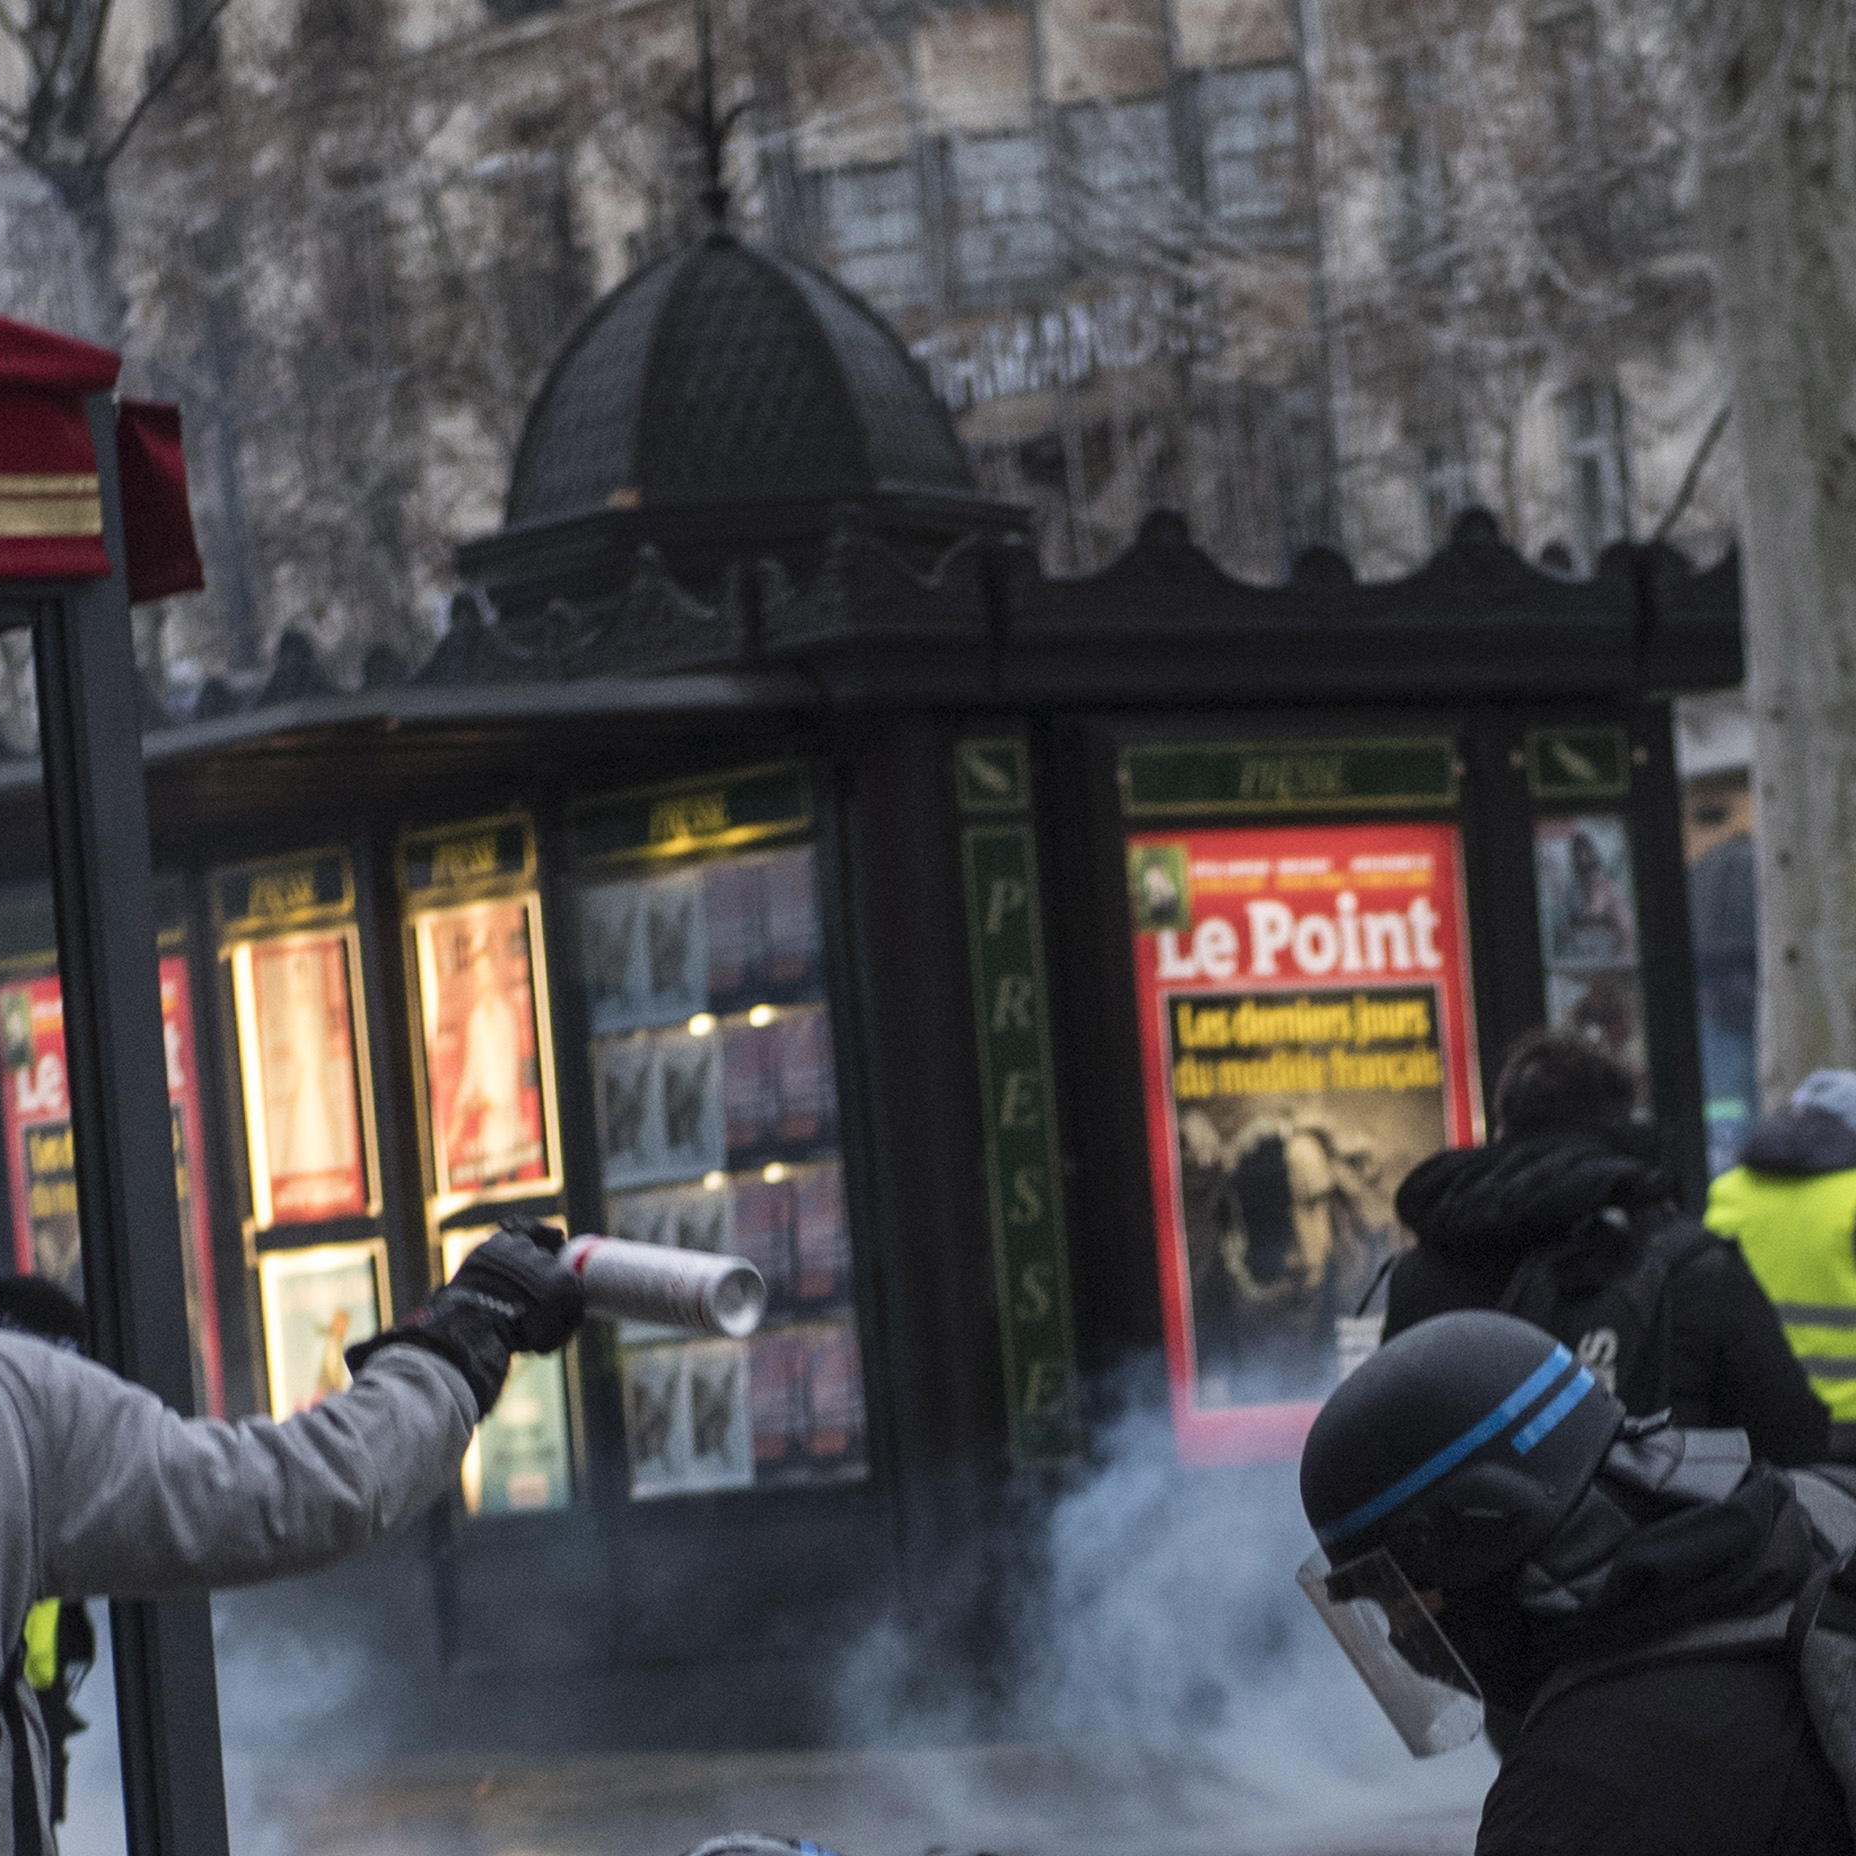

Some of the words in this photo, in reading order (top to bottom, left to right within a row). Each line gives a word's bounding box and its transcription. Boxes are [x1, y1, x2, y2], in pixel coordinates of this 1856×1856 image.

[1156, 915, 1240, 980] Le
[1246, 891, 1443, 977] Point
[1176, 1001, 1230, 1048] Les
[986, 876, 1067, 1416] PRESSE
